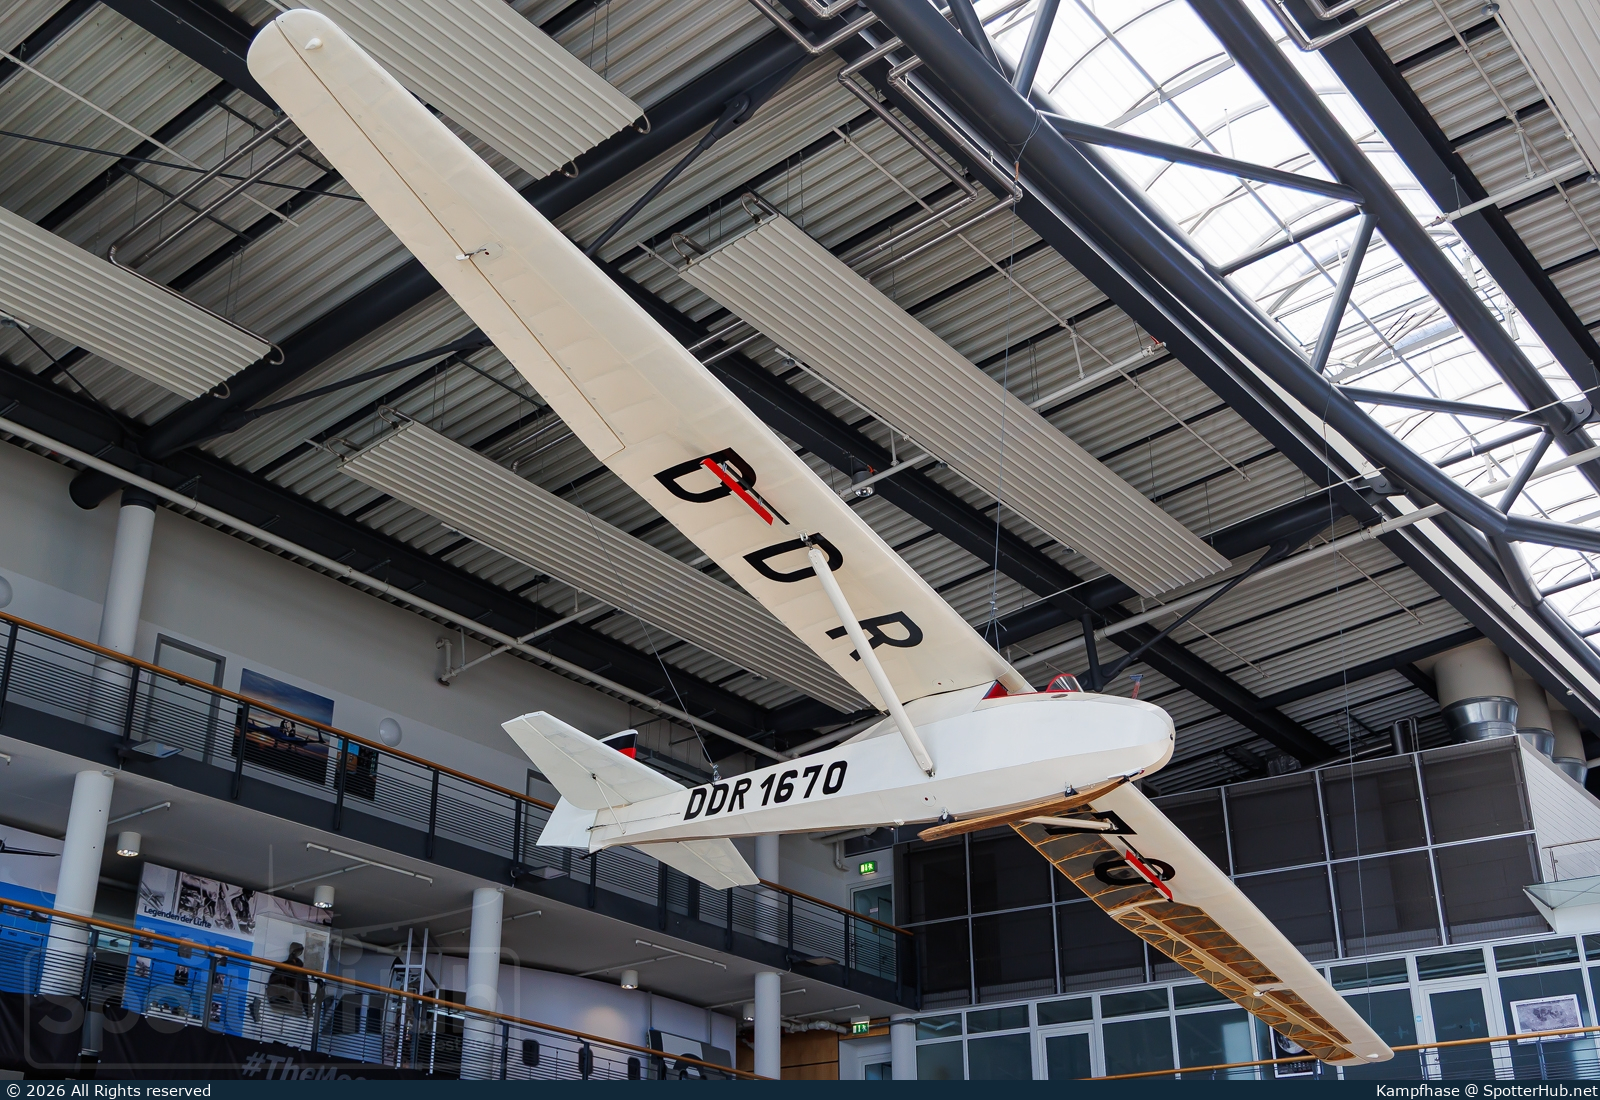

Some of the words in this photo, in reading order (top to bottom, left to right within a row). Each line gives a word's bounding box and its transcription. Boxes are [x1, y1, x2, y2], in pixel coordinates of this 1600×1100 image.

[683, 777, 752, 821] DDR
[760, 760, 848, 807] 1670
[144, 905, 180, 921] Legenden
[180, 914, 193, 924] der
[193, 916, 212, 928] Lüfte
